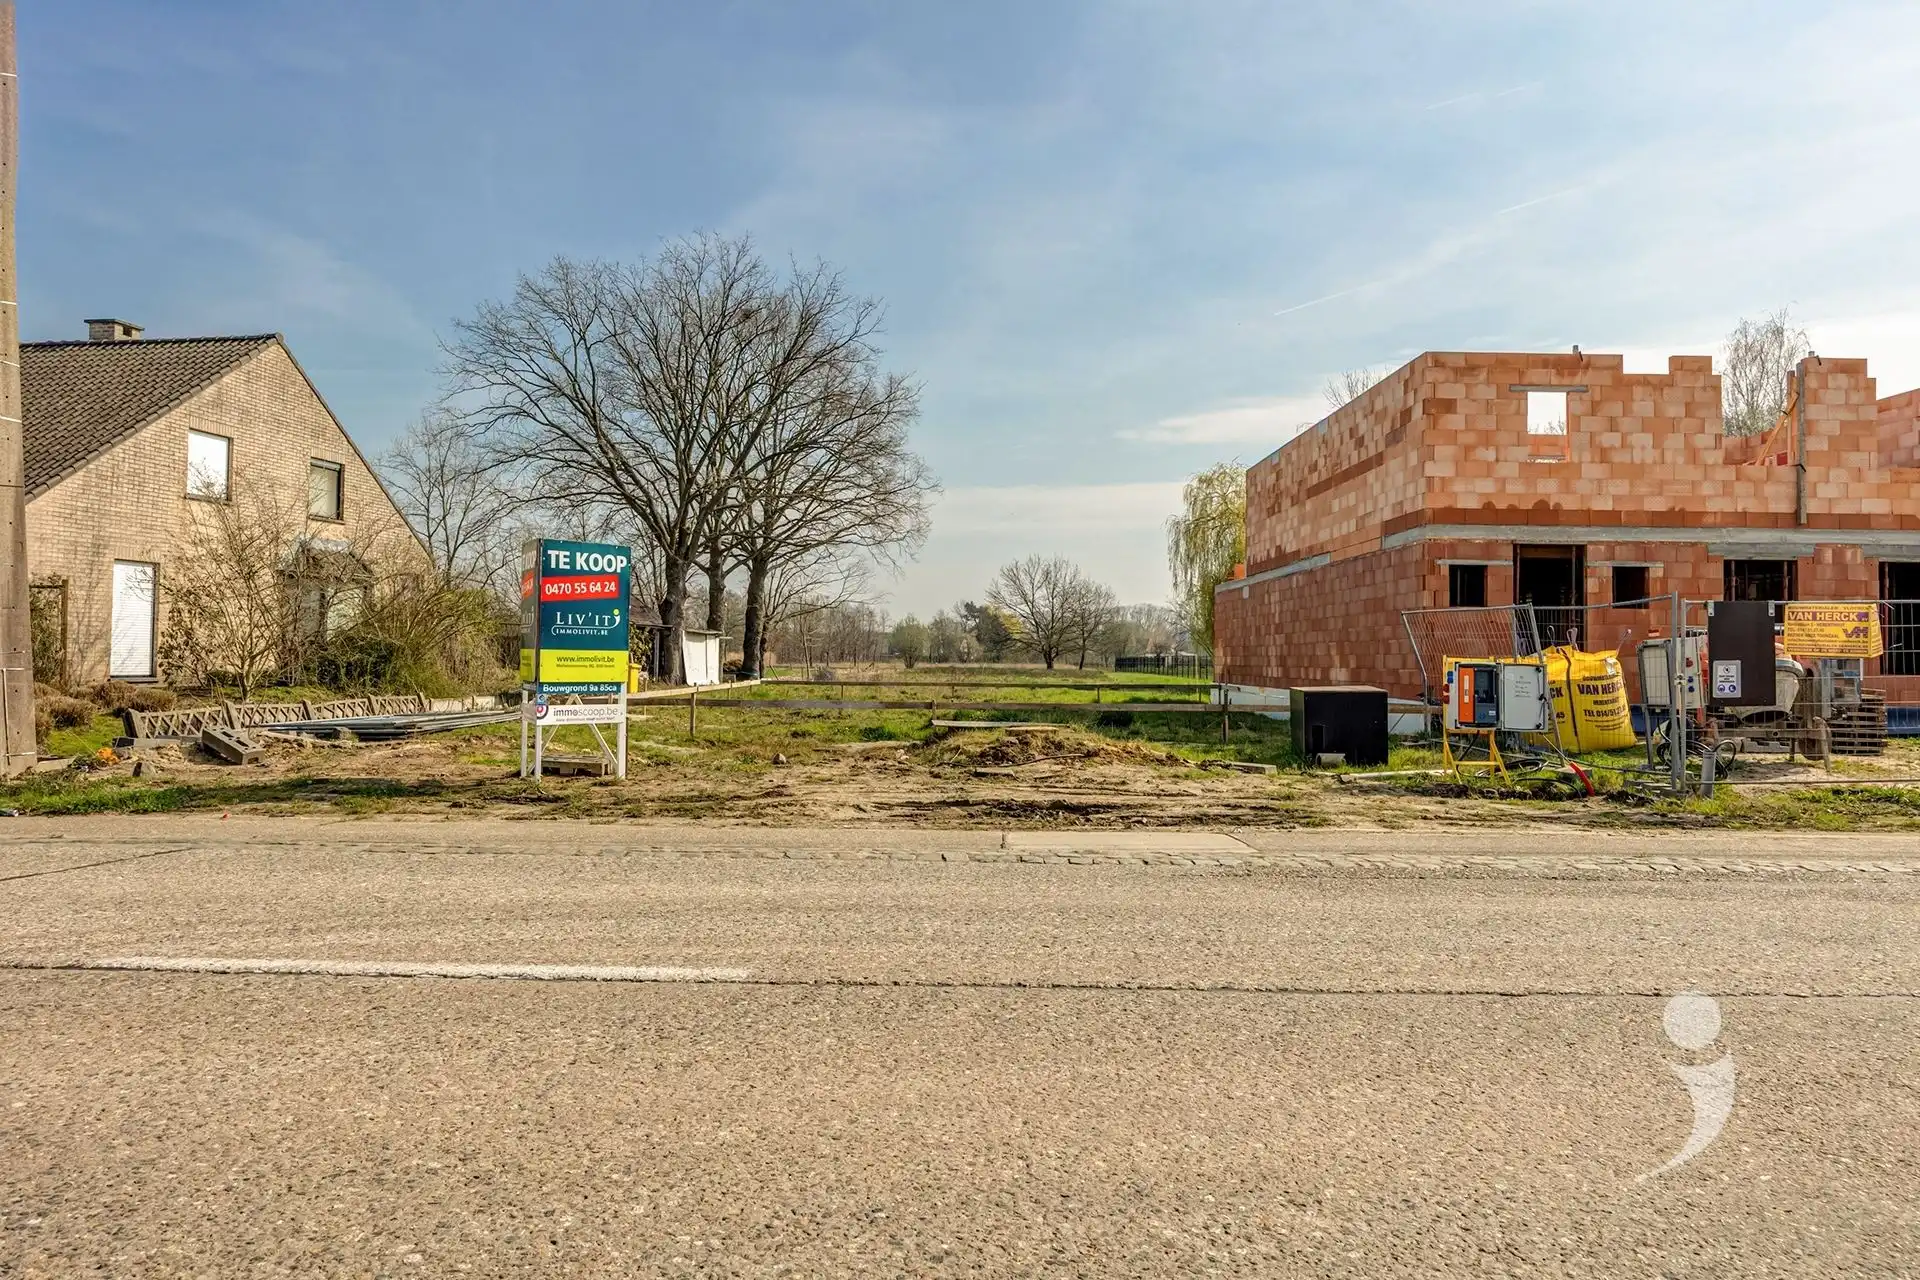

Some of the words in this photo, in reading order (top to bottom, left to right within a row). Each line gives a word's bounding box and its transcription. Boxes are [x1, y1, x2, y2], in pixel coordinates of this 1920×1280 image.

[547, 549, 570, 569] TE
[576, 552, 628, 573] KOOP
[545, 583, 572, 595] 0470
[574, 582, 587, 594] 55
[589, 581, 602, 593] 64
[604, 581, 616, 592] 24
[1789, 611, 1813, 621] VAN
[1816, 611, 1858, 621] HERCK
[556, 655, 615, 663] www.immolivit.be
[543, 684, 587, 693] Bouwgrond
[590, 684, 598, 692] 9a
[600, 684, 617, 692] 85ca
[1577, 683, 1600, 695] VAN
[553, 707, 618, 717] immoscoop.be
